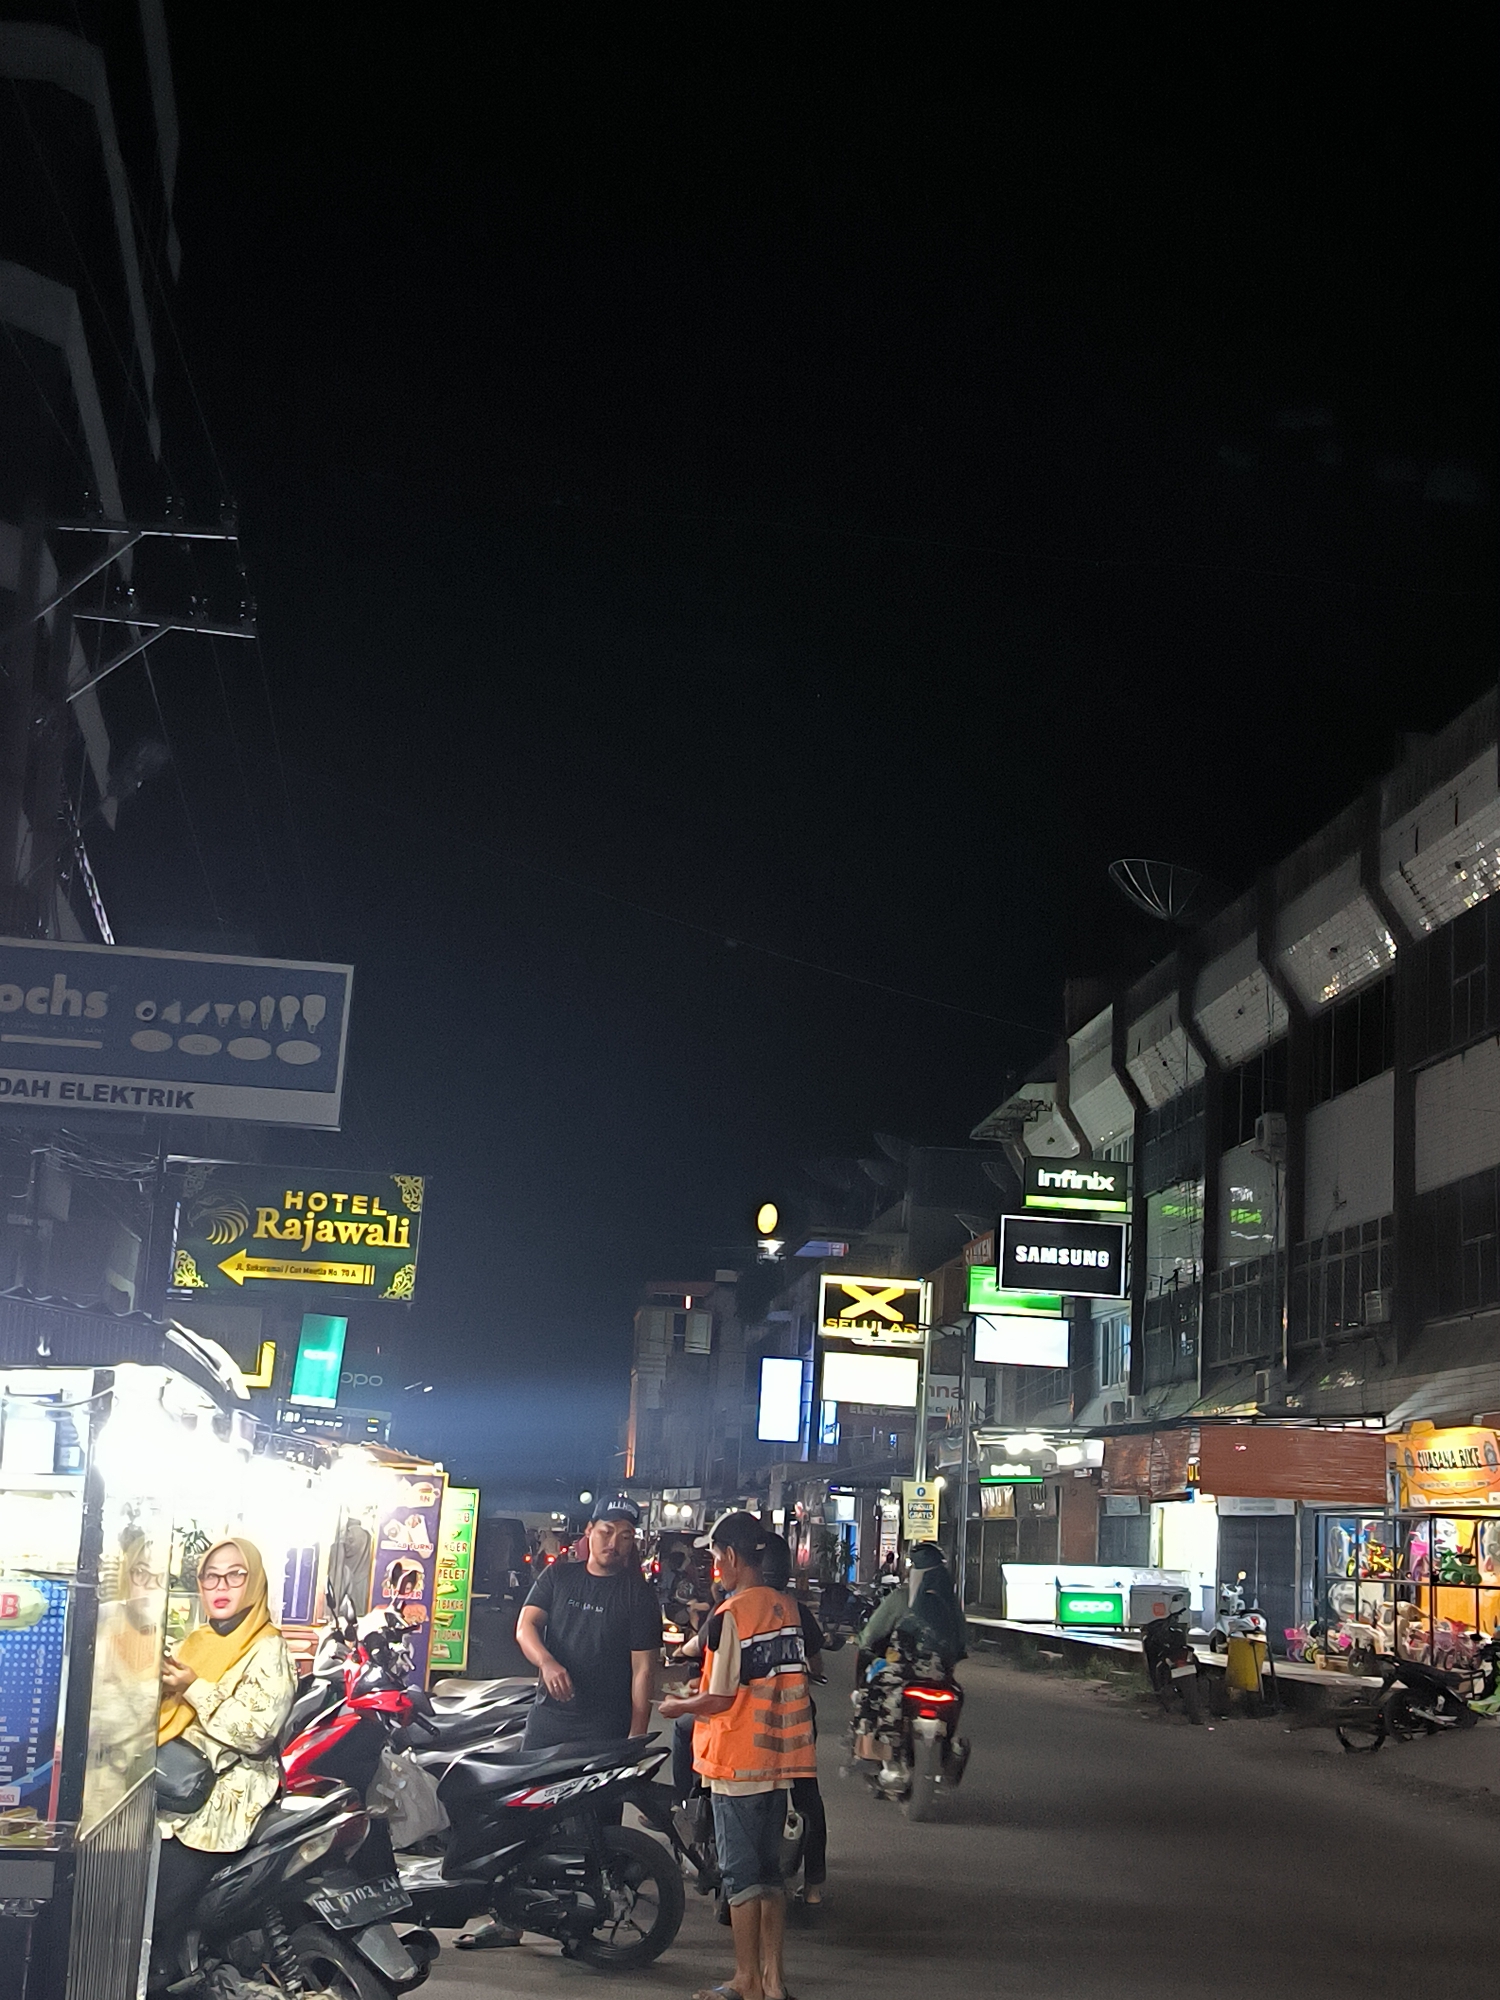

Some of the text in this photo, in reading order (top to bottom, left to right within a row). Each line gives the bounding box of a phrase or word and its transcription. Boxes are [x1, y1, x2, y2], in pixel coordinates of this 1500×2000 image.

[59, 1082, 195, 1109] ELEKTRIK
[284, 1191, 387, 1216] HOTEL
[253, 1207, 410, 1252] Rajawali
[1015, 1245, 1110, 1268] SAMSUNG
[1418, 1447, 1482, 1472] SUASANA BIKE
[909, 1511, 934, 1519] GRATIS
[1068, 1600, 1115, 1614] oppo
[319, 1899, 339, 1914] BL
